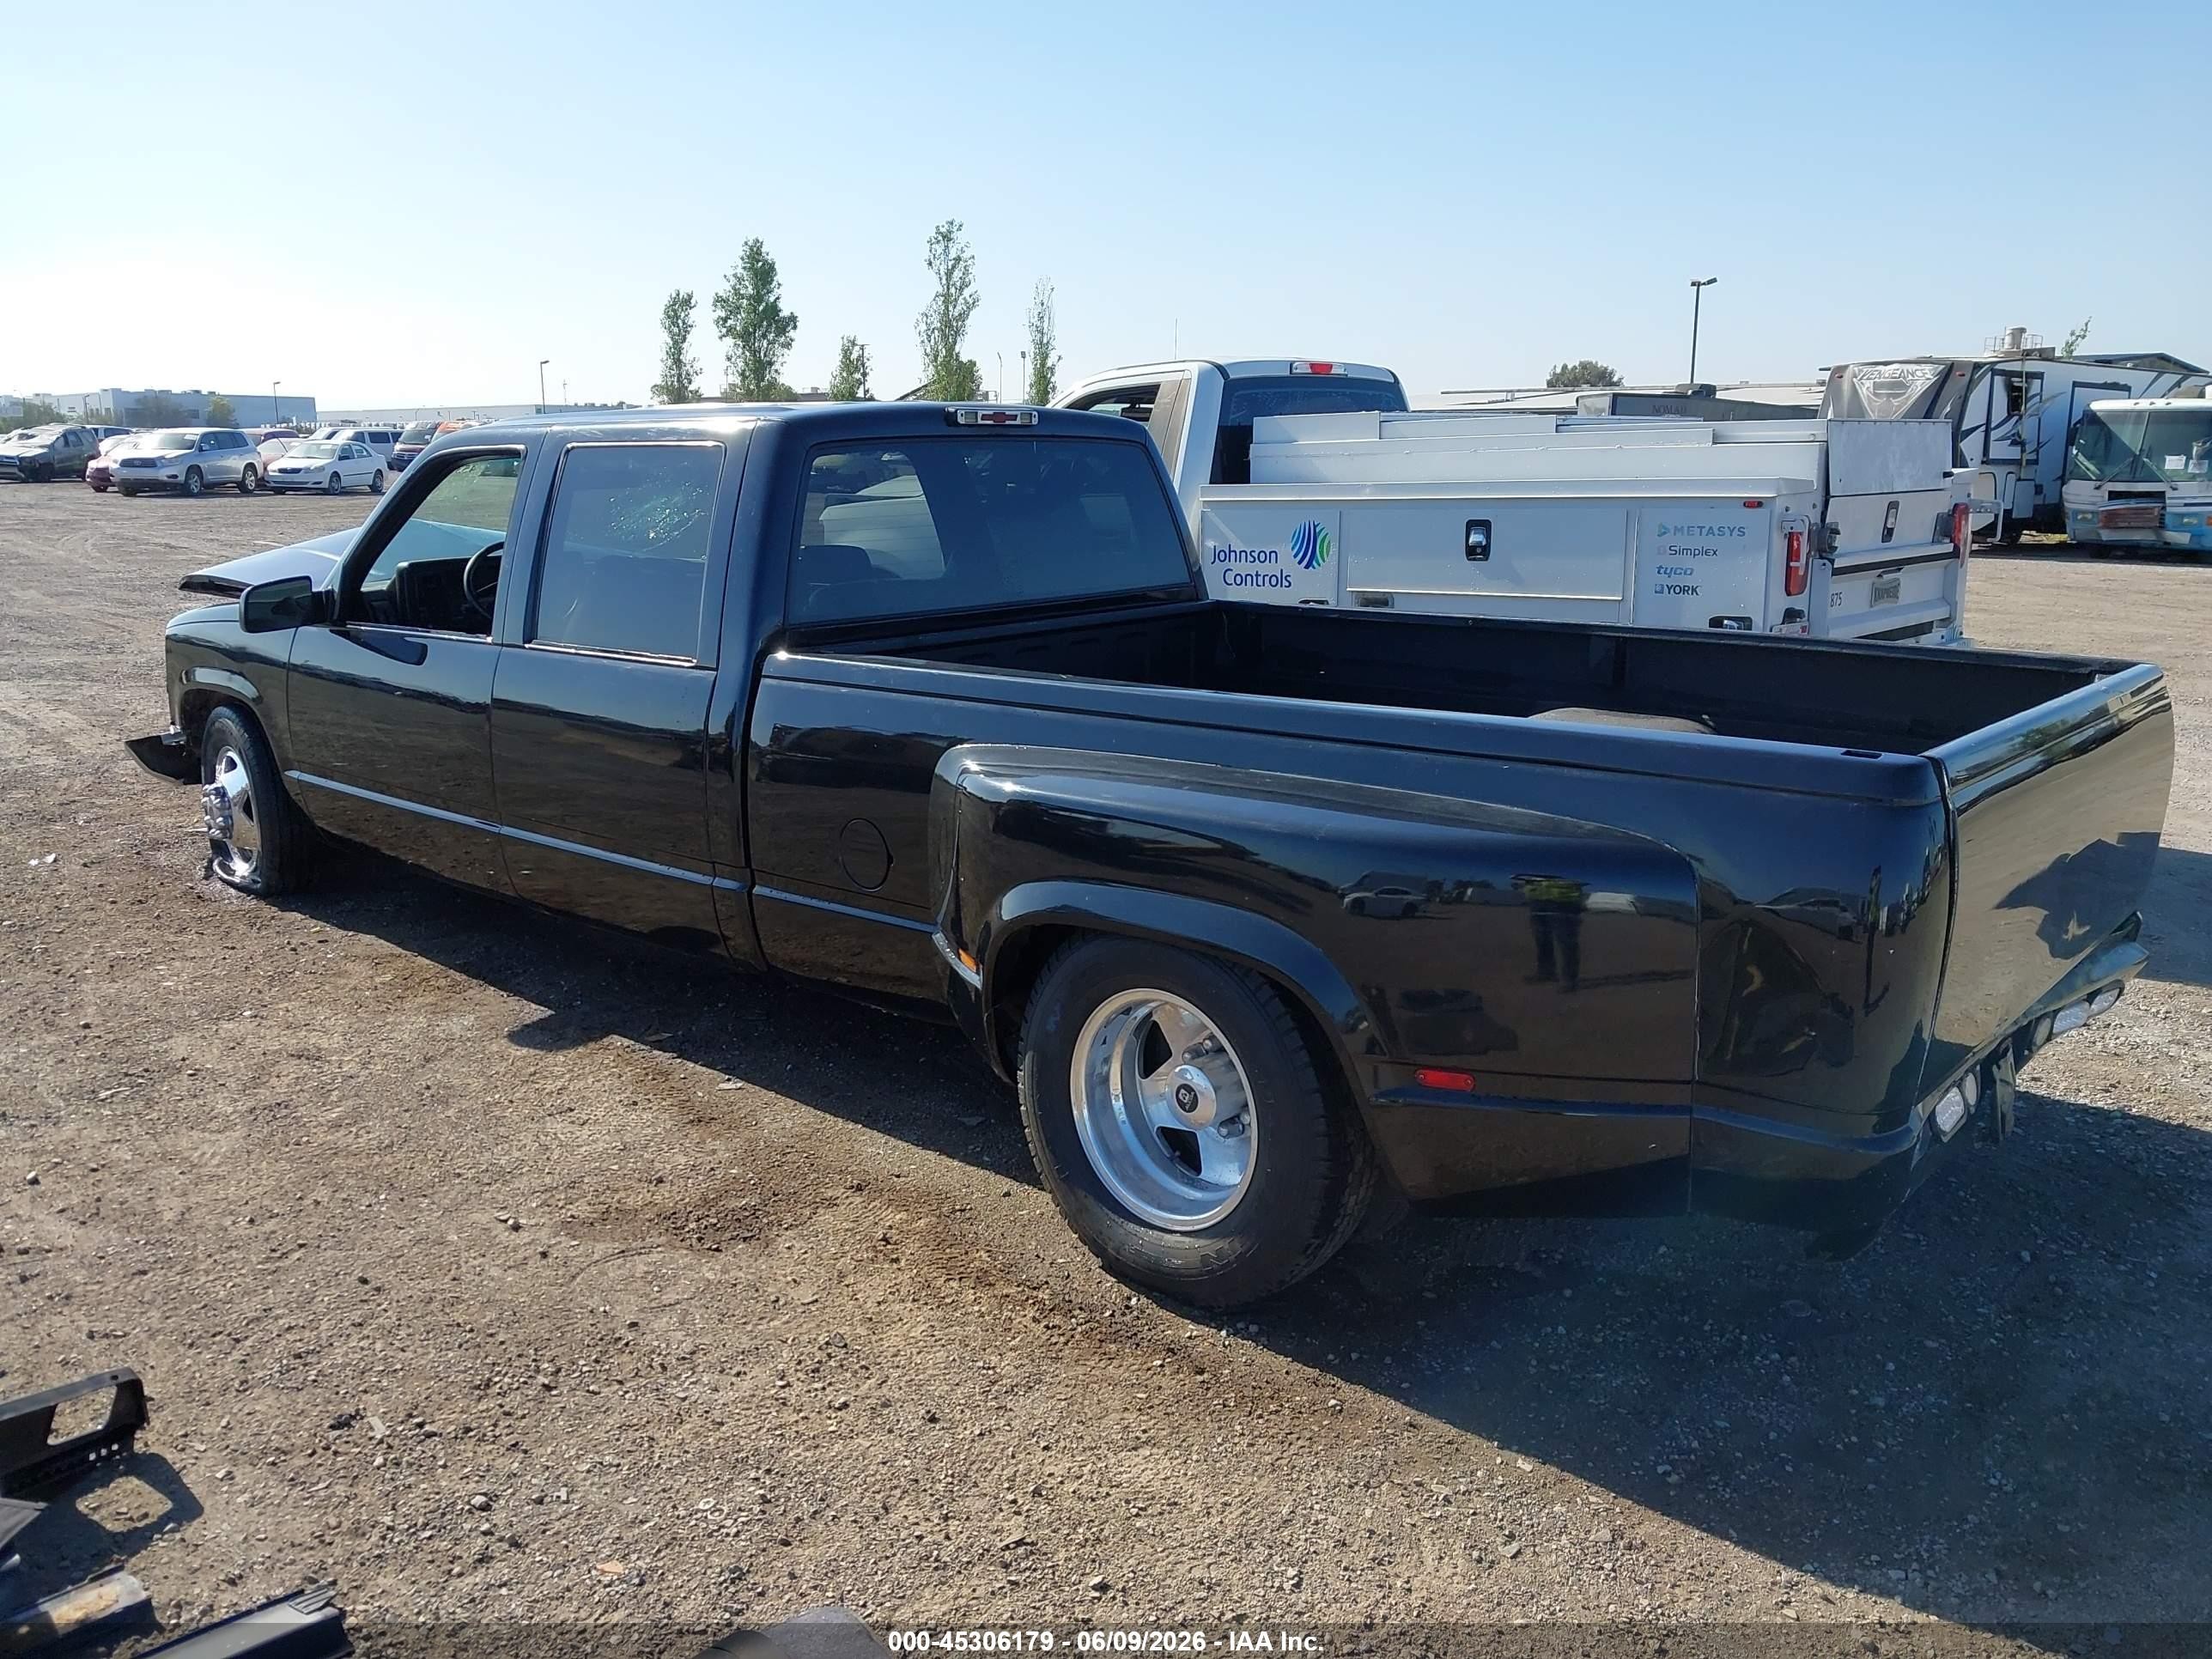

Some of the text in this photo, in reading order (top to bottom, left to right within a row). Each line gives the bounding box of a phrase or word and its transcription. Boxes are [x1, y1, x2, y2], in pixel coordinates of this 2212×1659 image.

[1857, 368, 1933, 380] VENGEANCE
[1673, 526, 1746, 538] METASYS
[1211, 544, 1279, 565] Johnson
[1668, 544, 1718, 558] Simplex
[1223, 568, 1292, 588] Controls
[1656, 564, 1694, 578] tyco
[1665, 584, 1700, 596] YORK
[1830, 591, 1843, 608] 875
